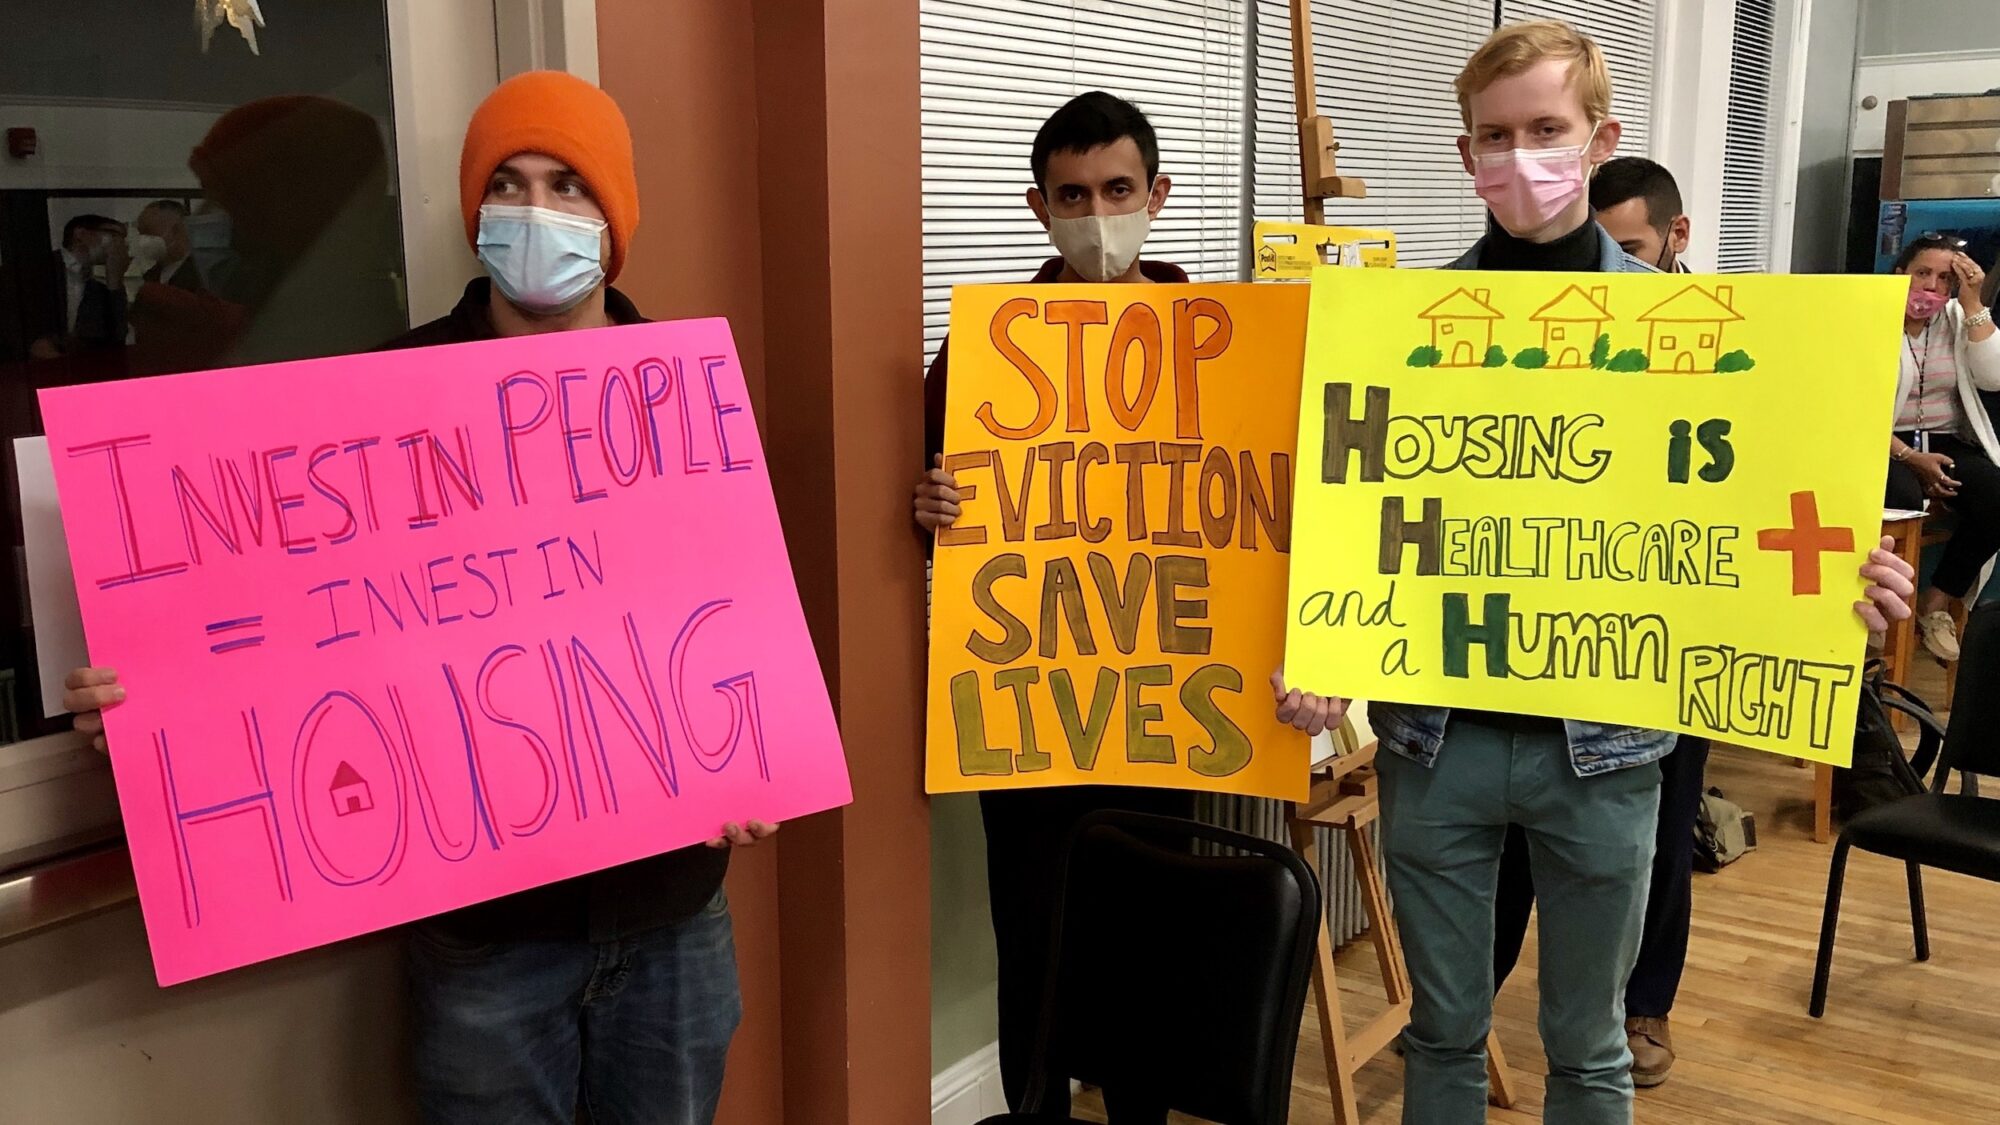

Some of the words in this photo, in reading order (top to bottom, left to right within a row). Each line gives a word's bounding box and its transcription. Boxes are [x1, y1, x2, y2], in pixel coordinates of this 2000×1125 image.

[974, 297, 1233, 440] STOP
[67, 435, 380, 590] INVEST
[395, 425, 485, 530] IN
[496, 354, 753, 506] PEOPLE
[1321, 382, 1612, 484] HOUSING
[937, 441, 1291, 554] EVICTION
[1378, 496, 1739, 588] HEALTHCARE
[306, 547, 519, 649] INVEST
[536, 531, 606, 600] IN
[965, 552, 1212, 664] SAVE
[1299, 581, 1405, 628] and
[950, 664, 1253, 777] LIVES
[1380, 638, 1419, 676] a
[1678, 644, 1854, 750] RIGHT
[152, 598, 771, 929] HOUSING
